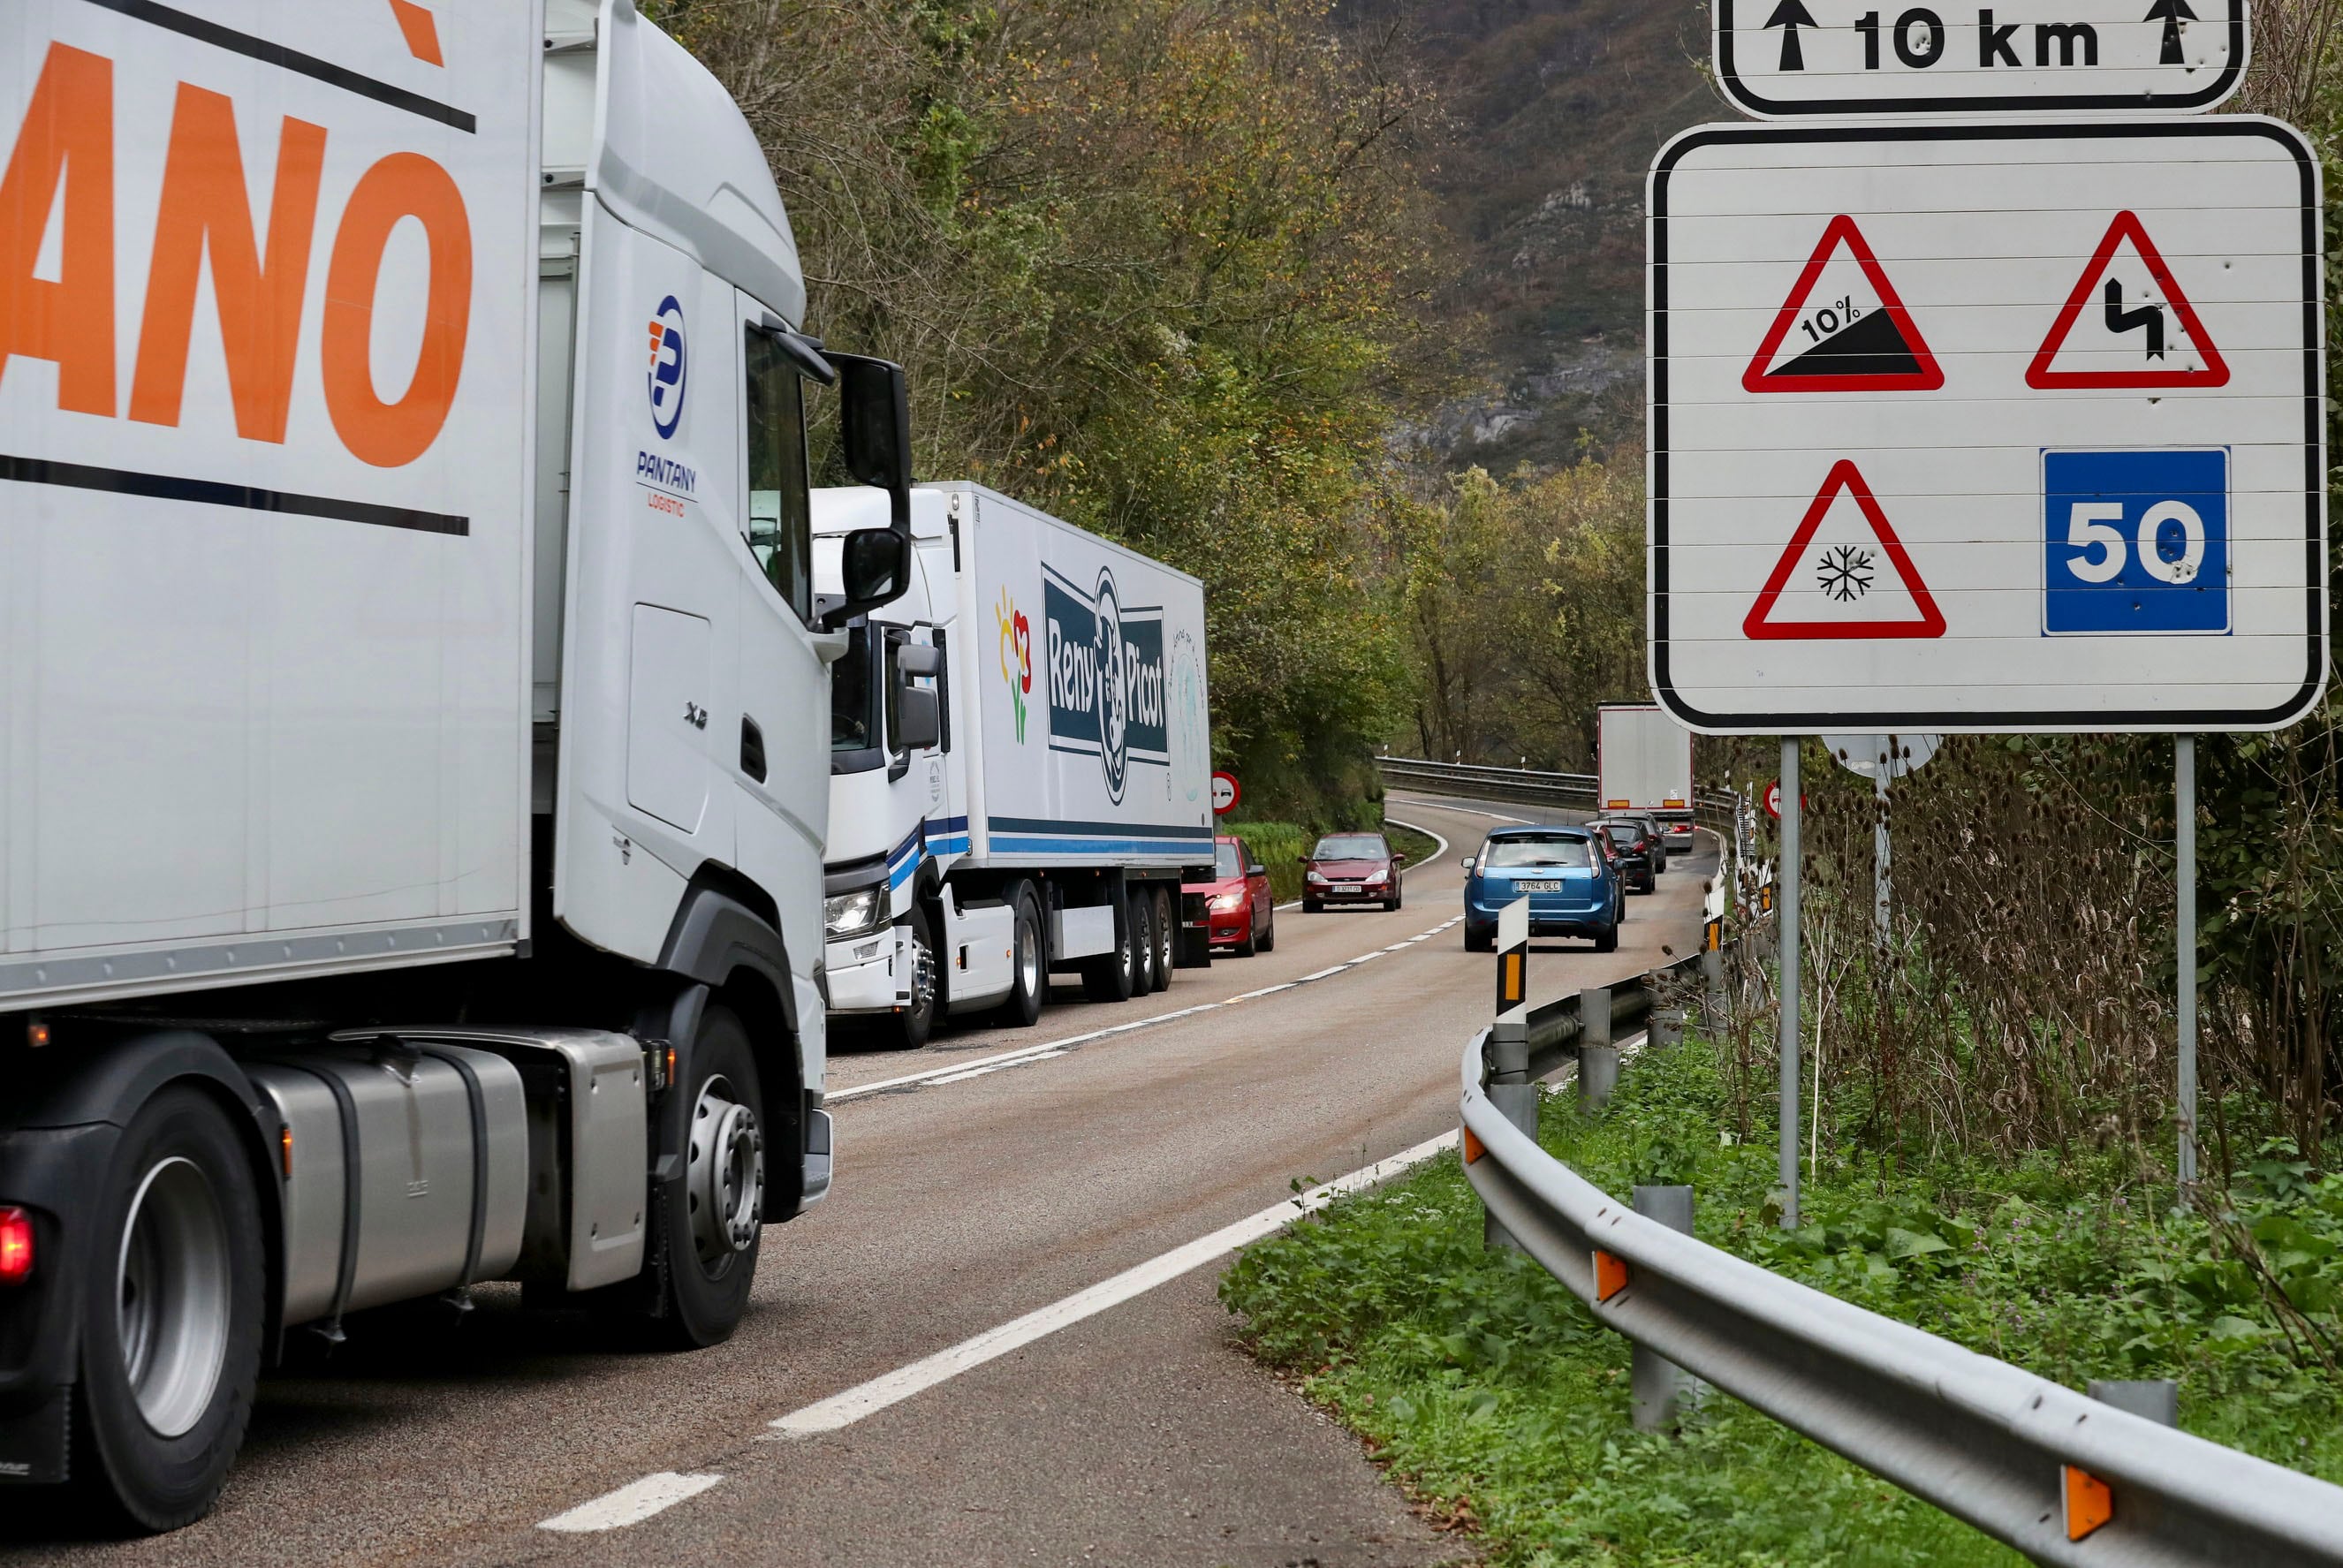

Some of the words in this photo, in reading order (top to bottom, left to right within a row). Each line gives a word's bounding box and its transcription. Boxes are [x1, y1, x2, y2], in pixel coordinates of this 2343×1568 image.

[1854, 7, 1945, 70] 10
[1978, 8, 2098, 68] km
[1801, 294, 1861, 343] 10%
[637, 451, 696, 493] PANTANY
[648, 493, 685, 519] LOGISTIC
[2066, 500, 2205, 584] 50
[1048, 617, 1095, 713] Reny
[1126, 641, 1164, 728] Picot
